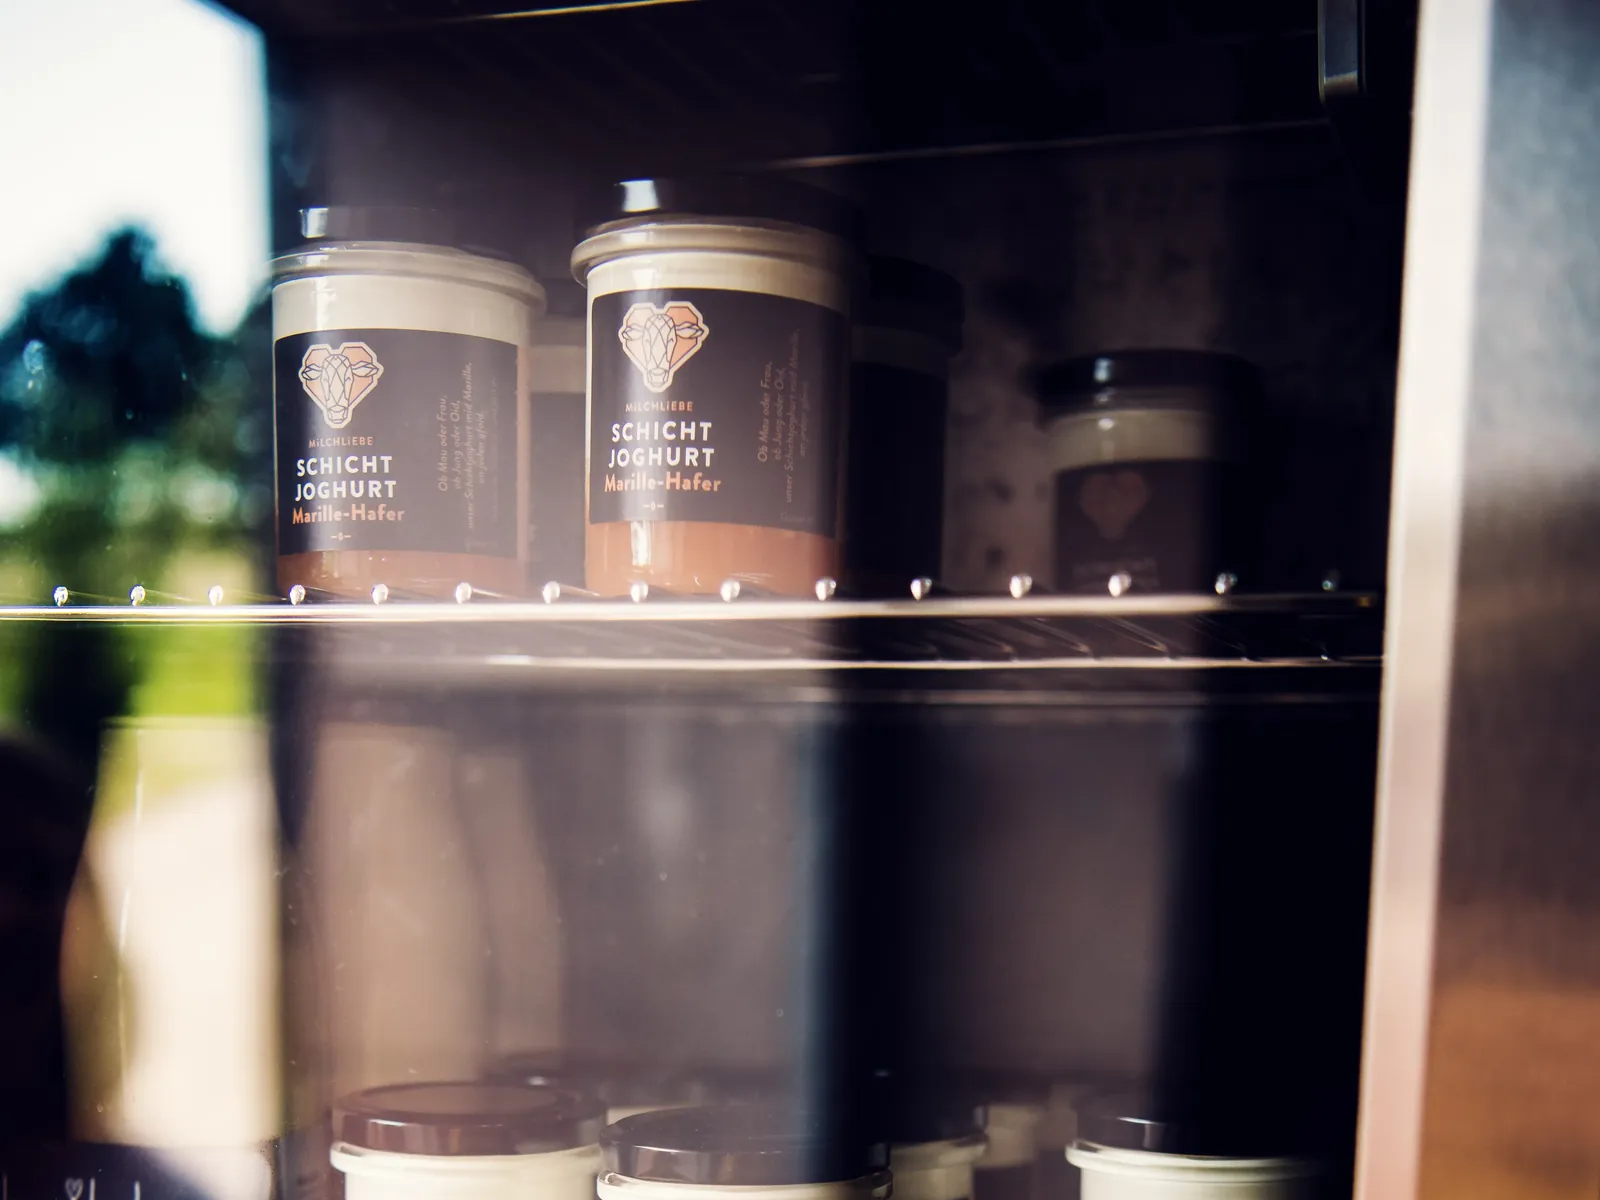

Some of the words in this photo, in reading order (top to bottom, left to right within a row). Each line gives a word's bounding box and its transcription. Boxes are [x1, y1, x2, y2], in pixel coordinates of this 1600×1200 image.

[761, 393, 770, 416] oder
[438, 425, 448, 447] oder
[451, 426, 460, 447] oder
[612, 421, 712, 443] SCHICHT
[297, 455, 393, 477] SCHICHT
[452, 450, 464, 474] Jung
[608, 447, 714, 469] JOGHURT
[295, 480, 397, 501] JOGHURT
[604, 471, 721, 493] Marille-Hafer
[292, 503, 405, 525] Marille-Hafer
